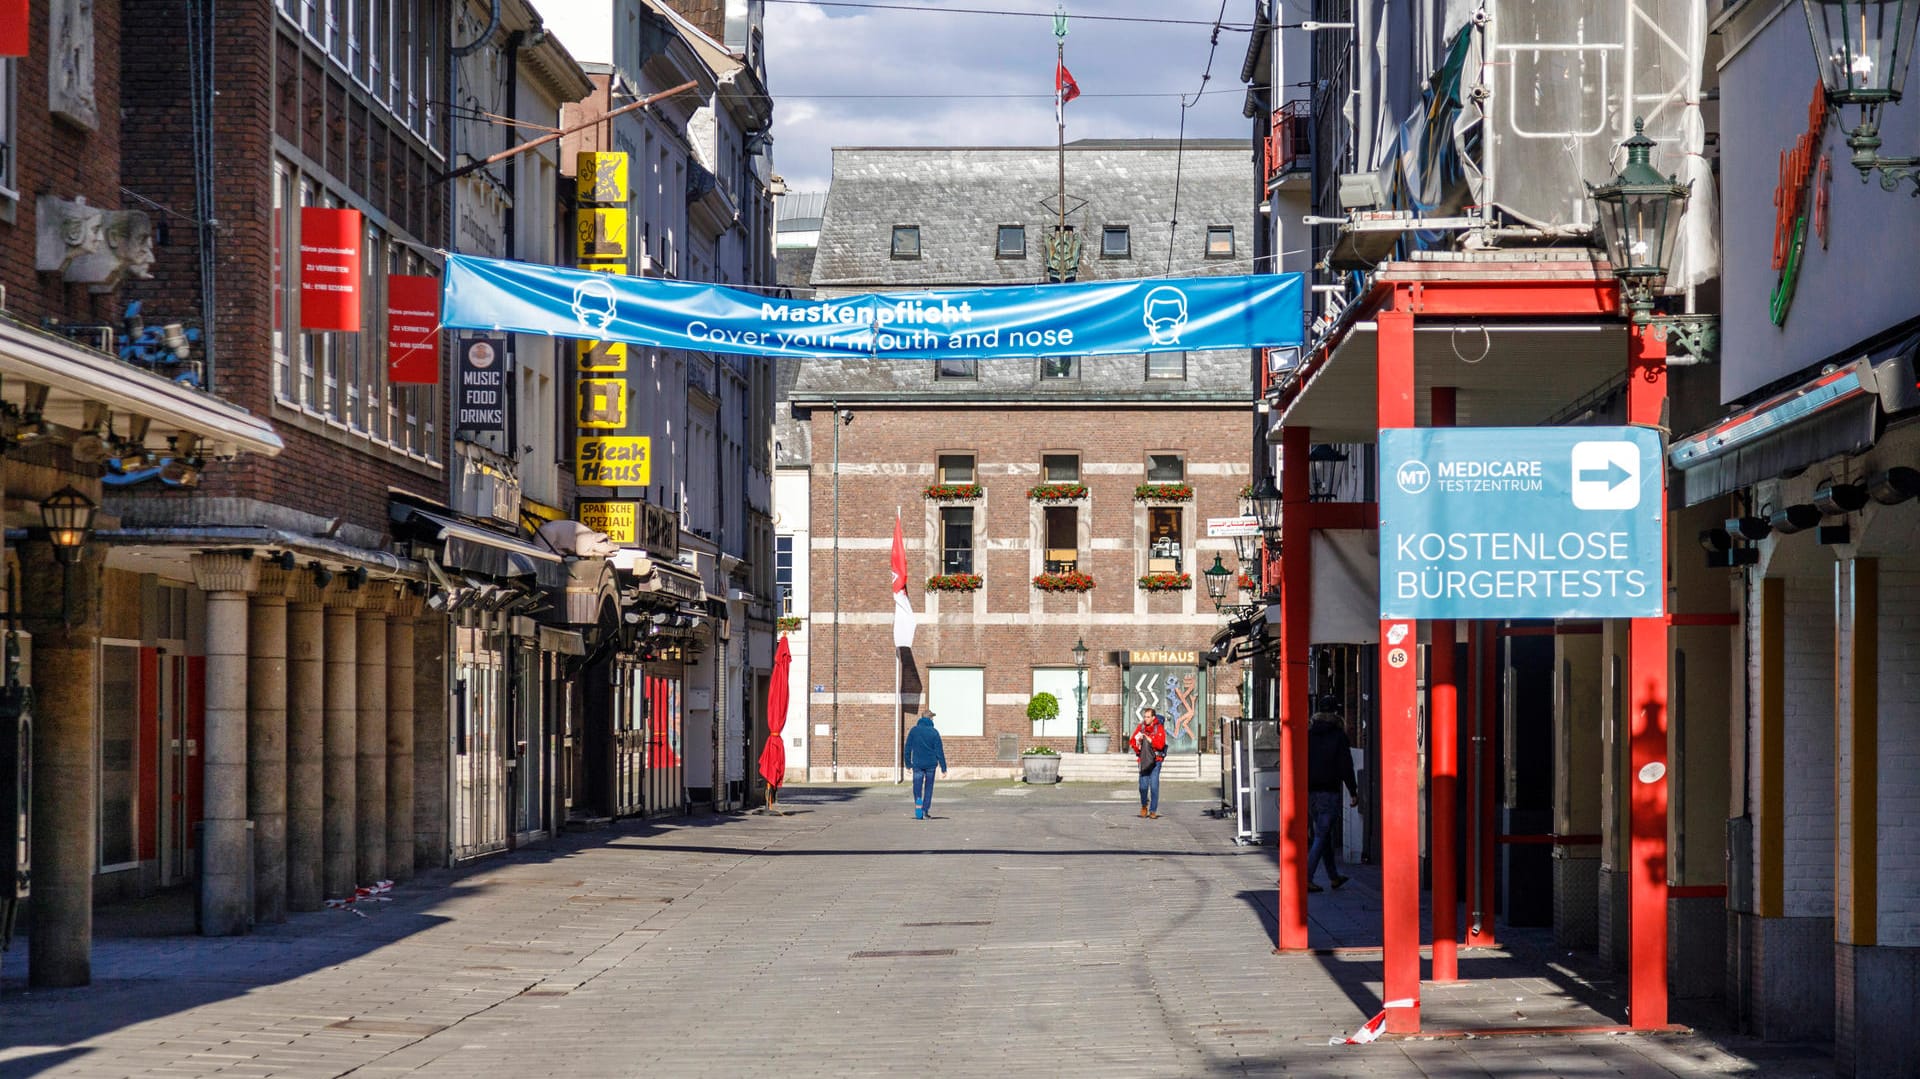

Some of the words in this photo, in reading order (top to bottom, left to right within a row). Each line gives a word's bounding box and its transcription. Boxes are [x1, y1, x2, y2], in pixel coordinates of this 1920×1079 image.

[760, 300, 972, 328] Maskenpflicht
[687, 321, 769, 345] Cover
[777, 333, 840, 350] your
[847, 328, 938, 351] mouth
[949, 327, 999, 349] and
[1009, 328, 1074, 348] nose
[463, 371, 500, 385] MUSIC
[466, 390, 497, 404] FOOD
[460, 409, 502, 423] DRINKS
[581, 442, 645, 461] Steak
[582, 462, 642, 482] Haus
[1438, 462, 1542, 477] MEDICARE
[1401, 470, 1427, 485] MT
[1438, 479, 1543, 492] TESTZENTRUM
[583, 504, 632, 514] SPANISCHE
[1397, 532, 1629, 560] KOSTENLOSE
[1398, 566, 1646, 599] BÜRGERTESTS
[1133, 652, 1195, 663] RATHAUS
[1391, 652, 1405, 663] 68
